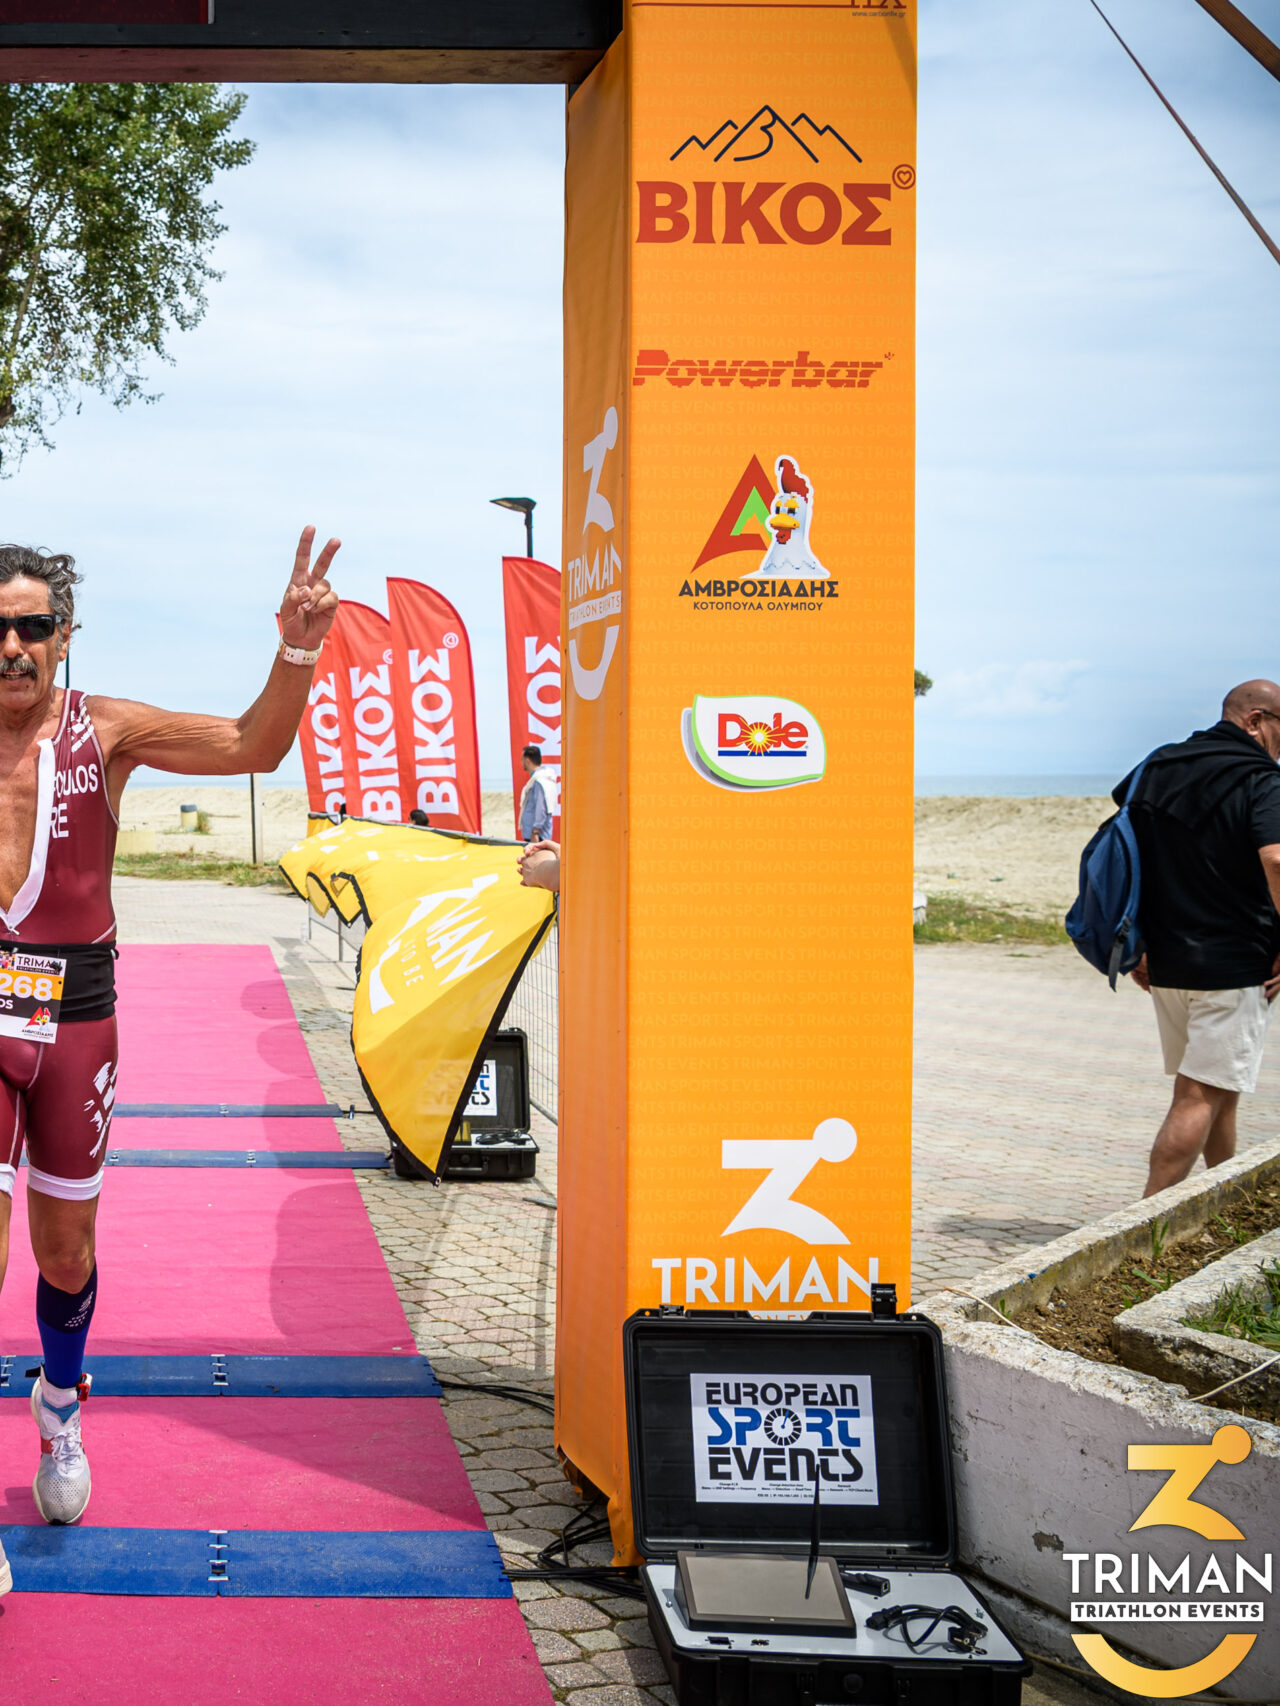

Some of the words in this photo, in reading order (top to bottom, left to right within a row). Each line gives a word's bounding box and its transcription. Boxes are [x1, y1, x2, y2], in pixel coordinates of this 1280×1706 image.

[635, 181, 892, 246] ΒΙΚΟΣ
[632, 349, 884, 388] Powerbar
[567, 541, 622, 602] TRIMAN
[678, 579, 839, 598] ΑΜΒΡΟΣΙΑΔΗΣ
[693, 600, 763, 611] ΚΟΤΟΠΟΥΛΑ
[767, 601, 823, 611] ΟΛΥΜΠΟΥ
[349, 664, 402, 821] ΒΙΚΟΣ
[408, 648, 459, 815] ΒΙΚΟΣ
[717, 712, 809, 753] Dole
[651, 1256, 879, 1303] TRIMAN
[705, 1382, 860, 1407] EUROPEAN
[707, 1407, 862, 1447] SPORT
[708, 1447, 864, 1482] EVENTS
